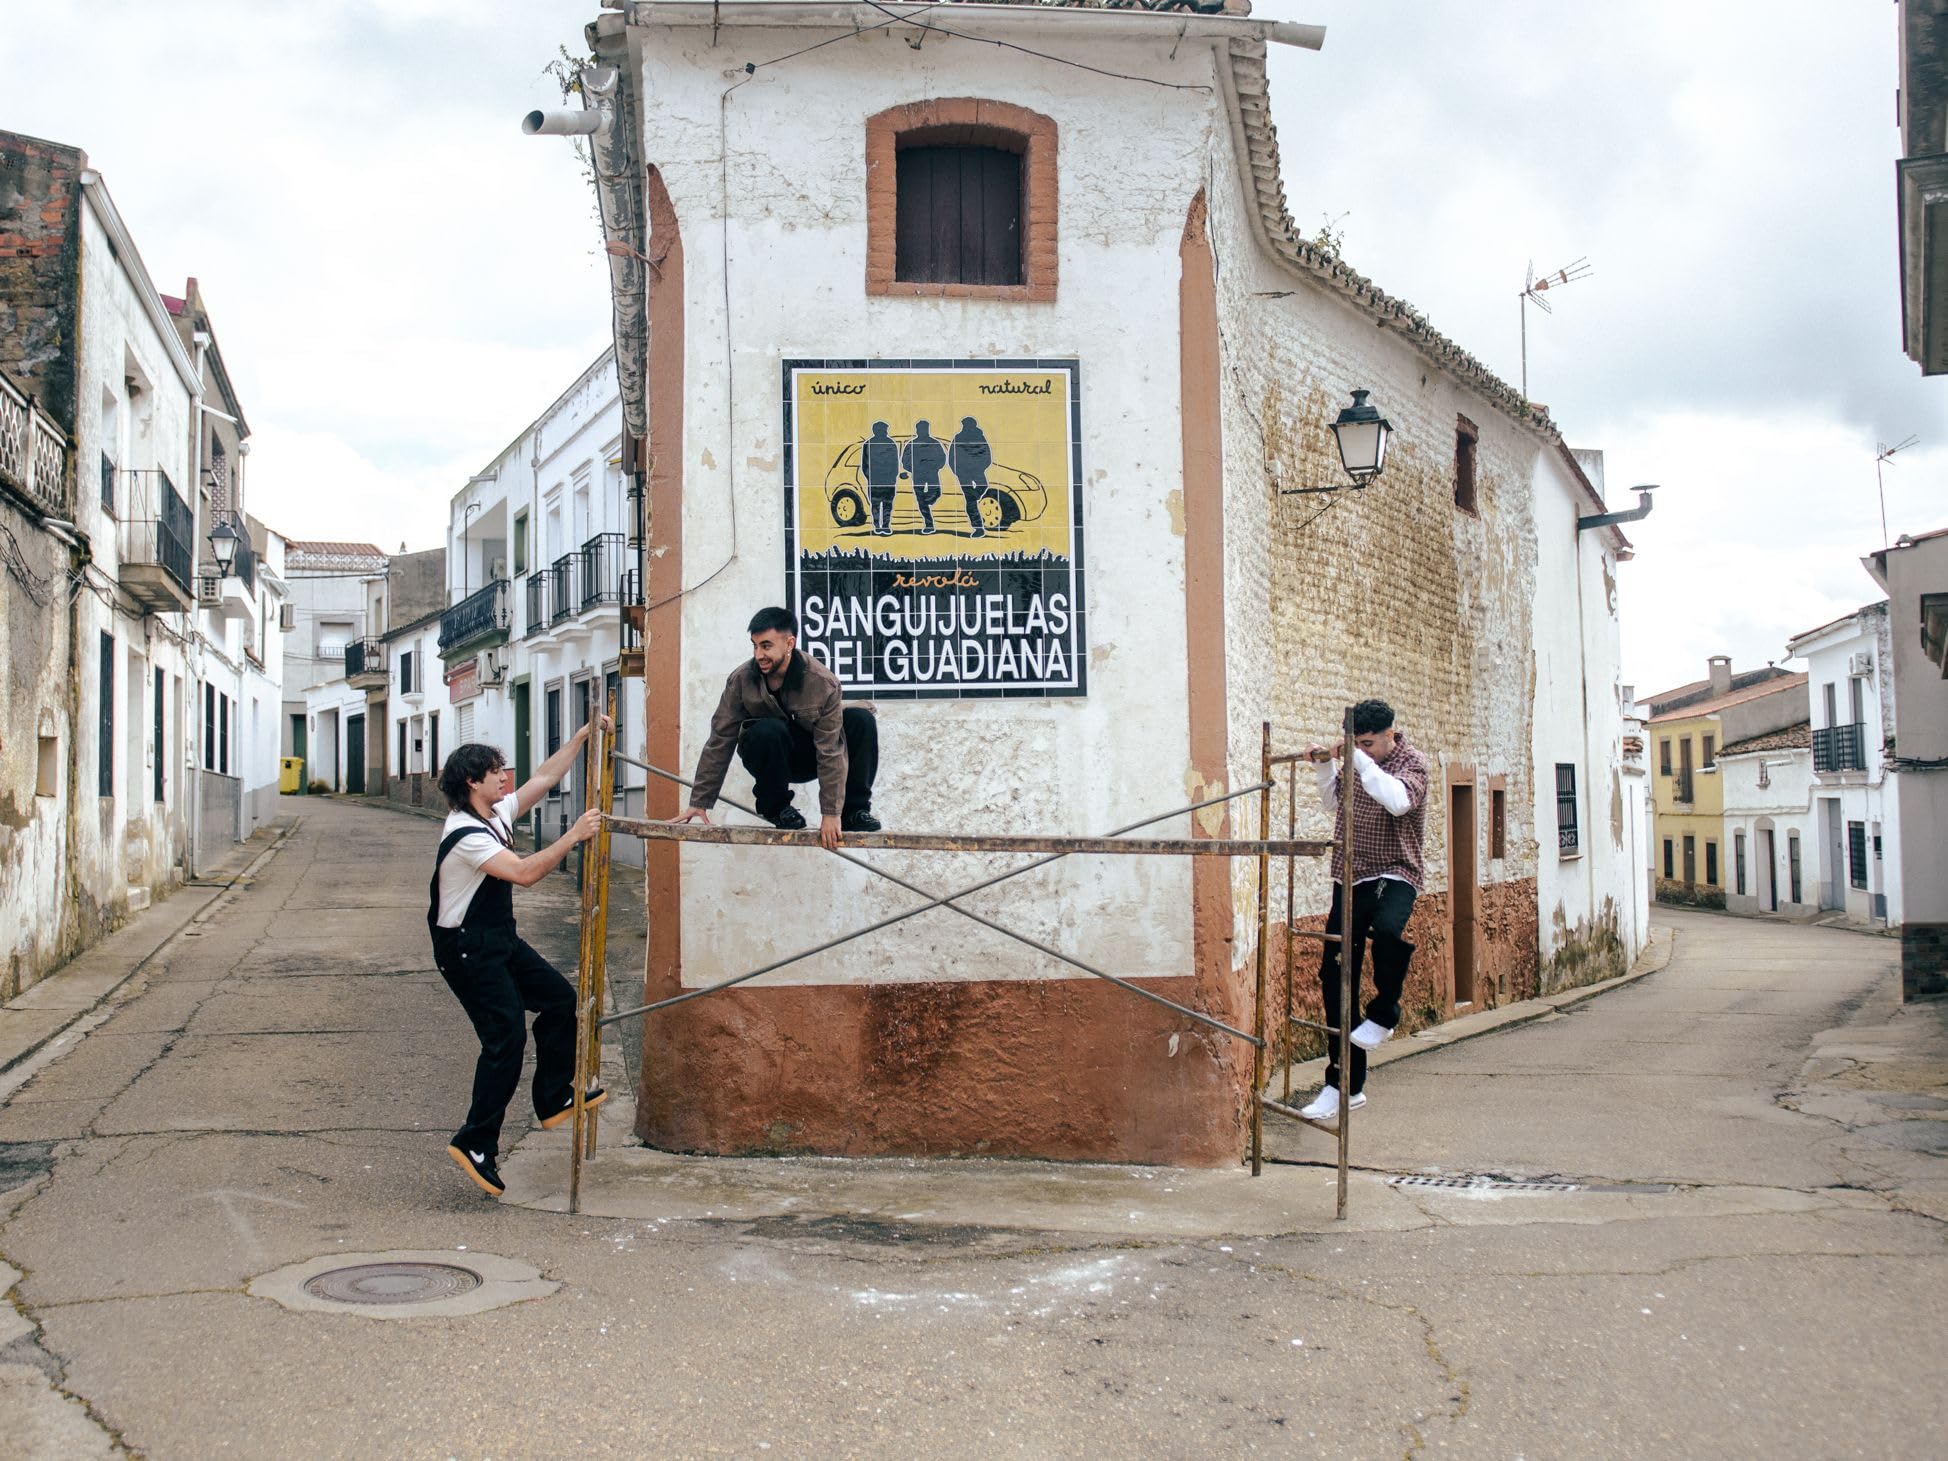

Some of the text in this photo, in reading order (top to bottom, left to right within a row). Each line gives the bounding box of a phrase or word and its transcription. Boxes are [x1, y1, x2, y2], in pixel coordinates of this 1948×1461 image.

[811, 380, 867, 395] único
[979, 379, 1052, 395] natural
[893, 567, 979, 588] revolá
[804, 593, 1069, 638] SANGUIJUELAS
[808, 638, 1069, 681] DEL GUADIANA
